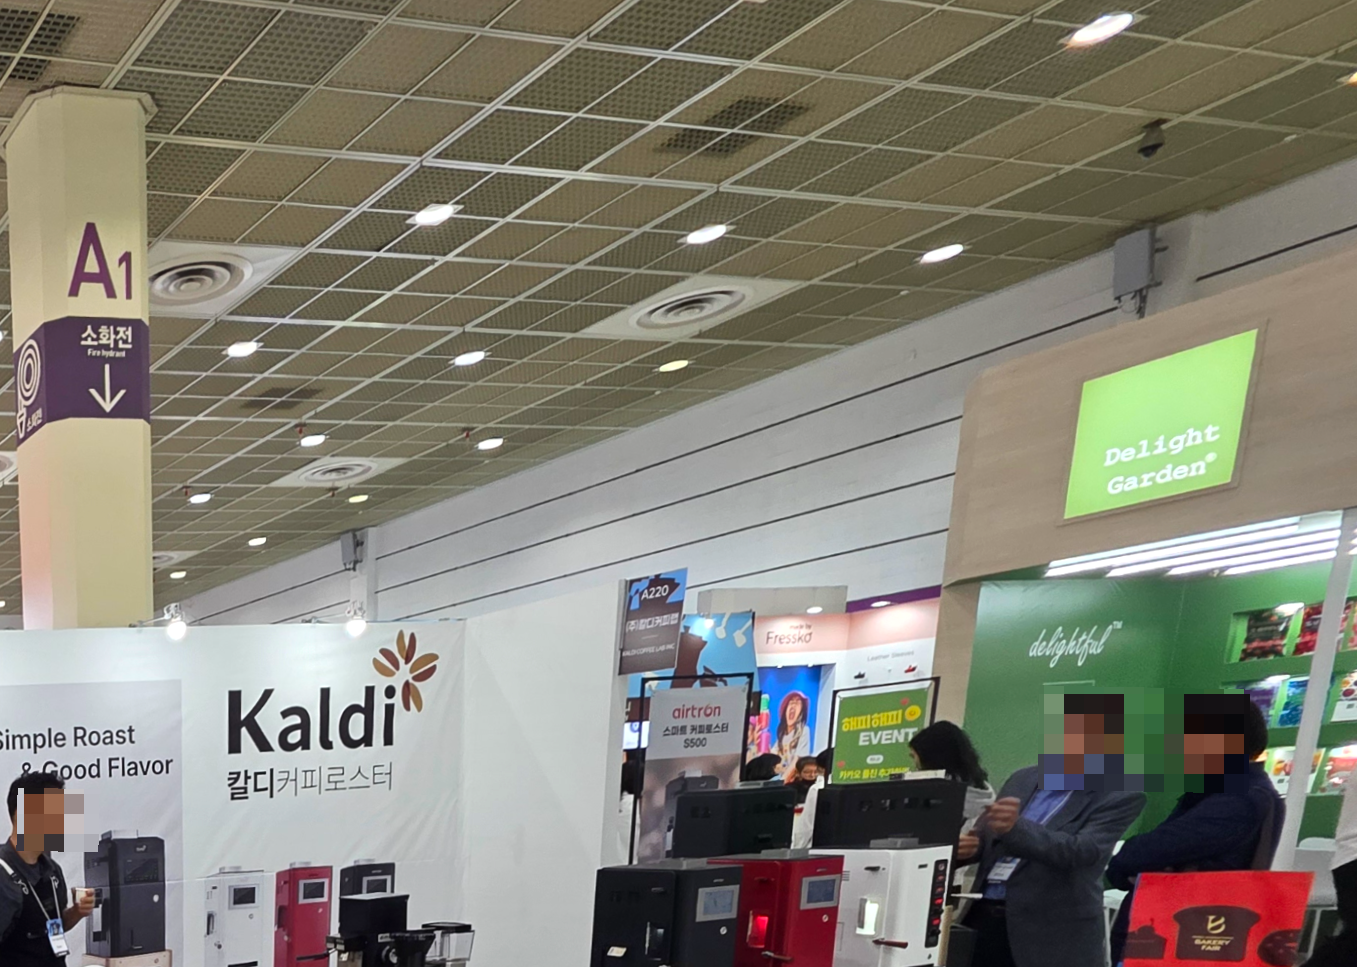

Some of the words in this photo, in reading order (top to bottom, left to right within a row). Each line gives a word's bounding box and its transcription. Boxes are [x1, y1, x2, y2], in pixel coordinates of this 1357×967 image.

[80, 325, 133, 349] 소화전
[87, 348, 101, 357] Fire
[101, 348, 125, 358] hydrant
[1103, 424, 1220, 467] Delight
[641, 584, 669, 600] A220
[227, 684, 397, 755] Kaldi
[662, 725, 688, 737] 스마트
[689, 722, 729, 736] 커피로스터
[73, 725, 136, 748] Roast
[683, 737, 707, 749] S500
[858, 727, 919, 746] EVENT
[43, 758, 101, 780] Good
[108, 757, 174, 778] Flavor
[227, 762, 393, 801] 칼디커피로스터
